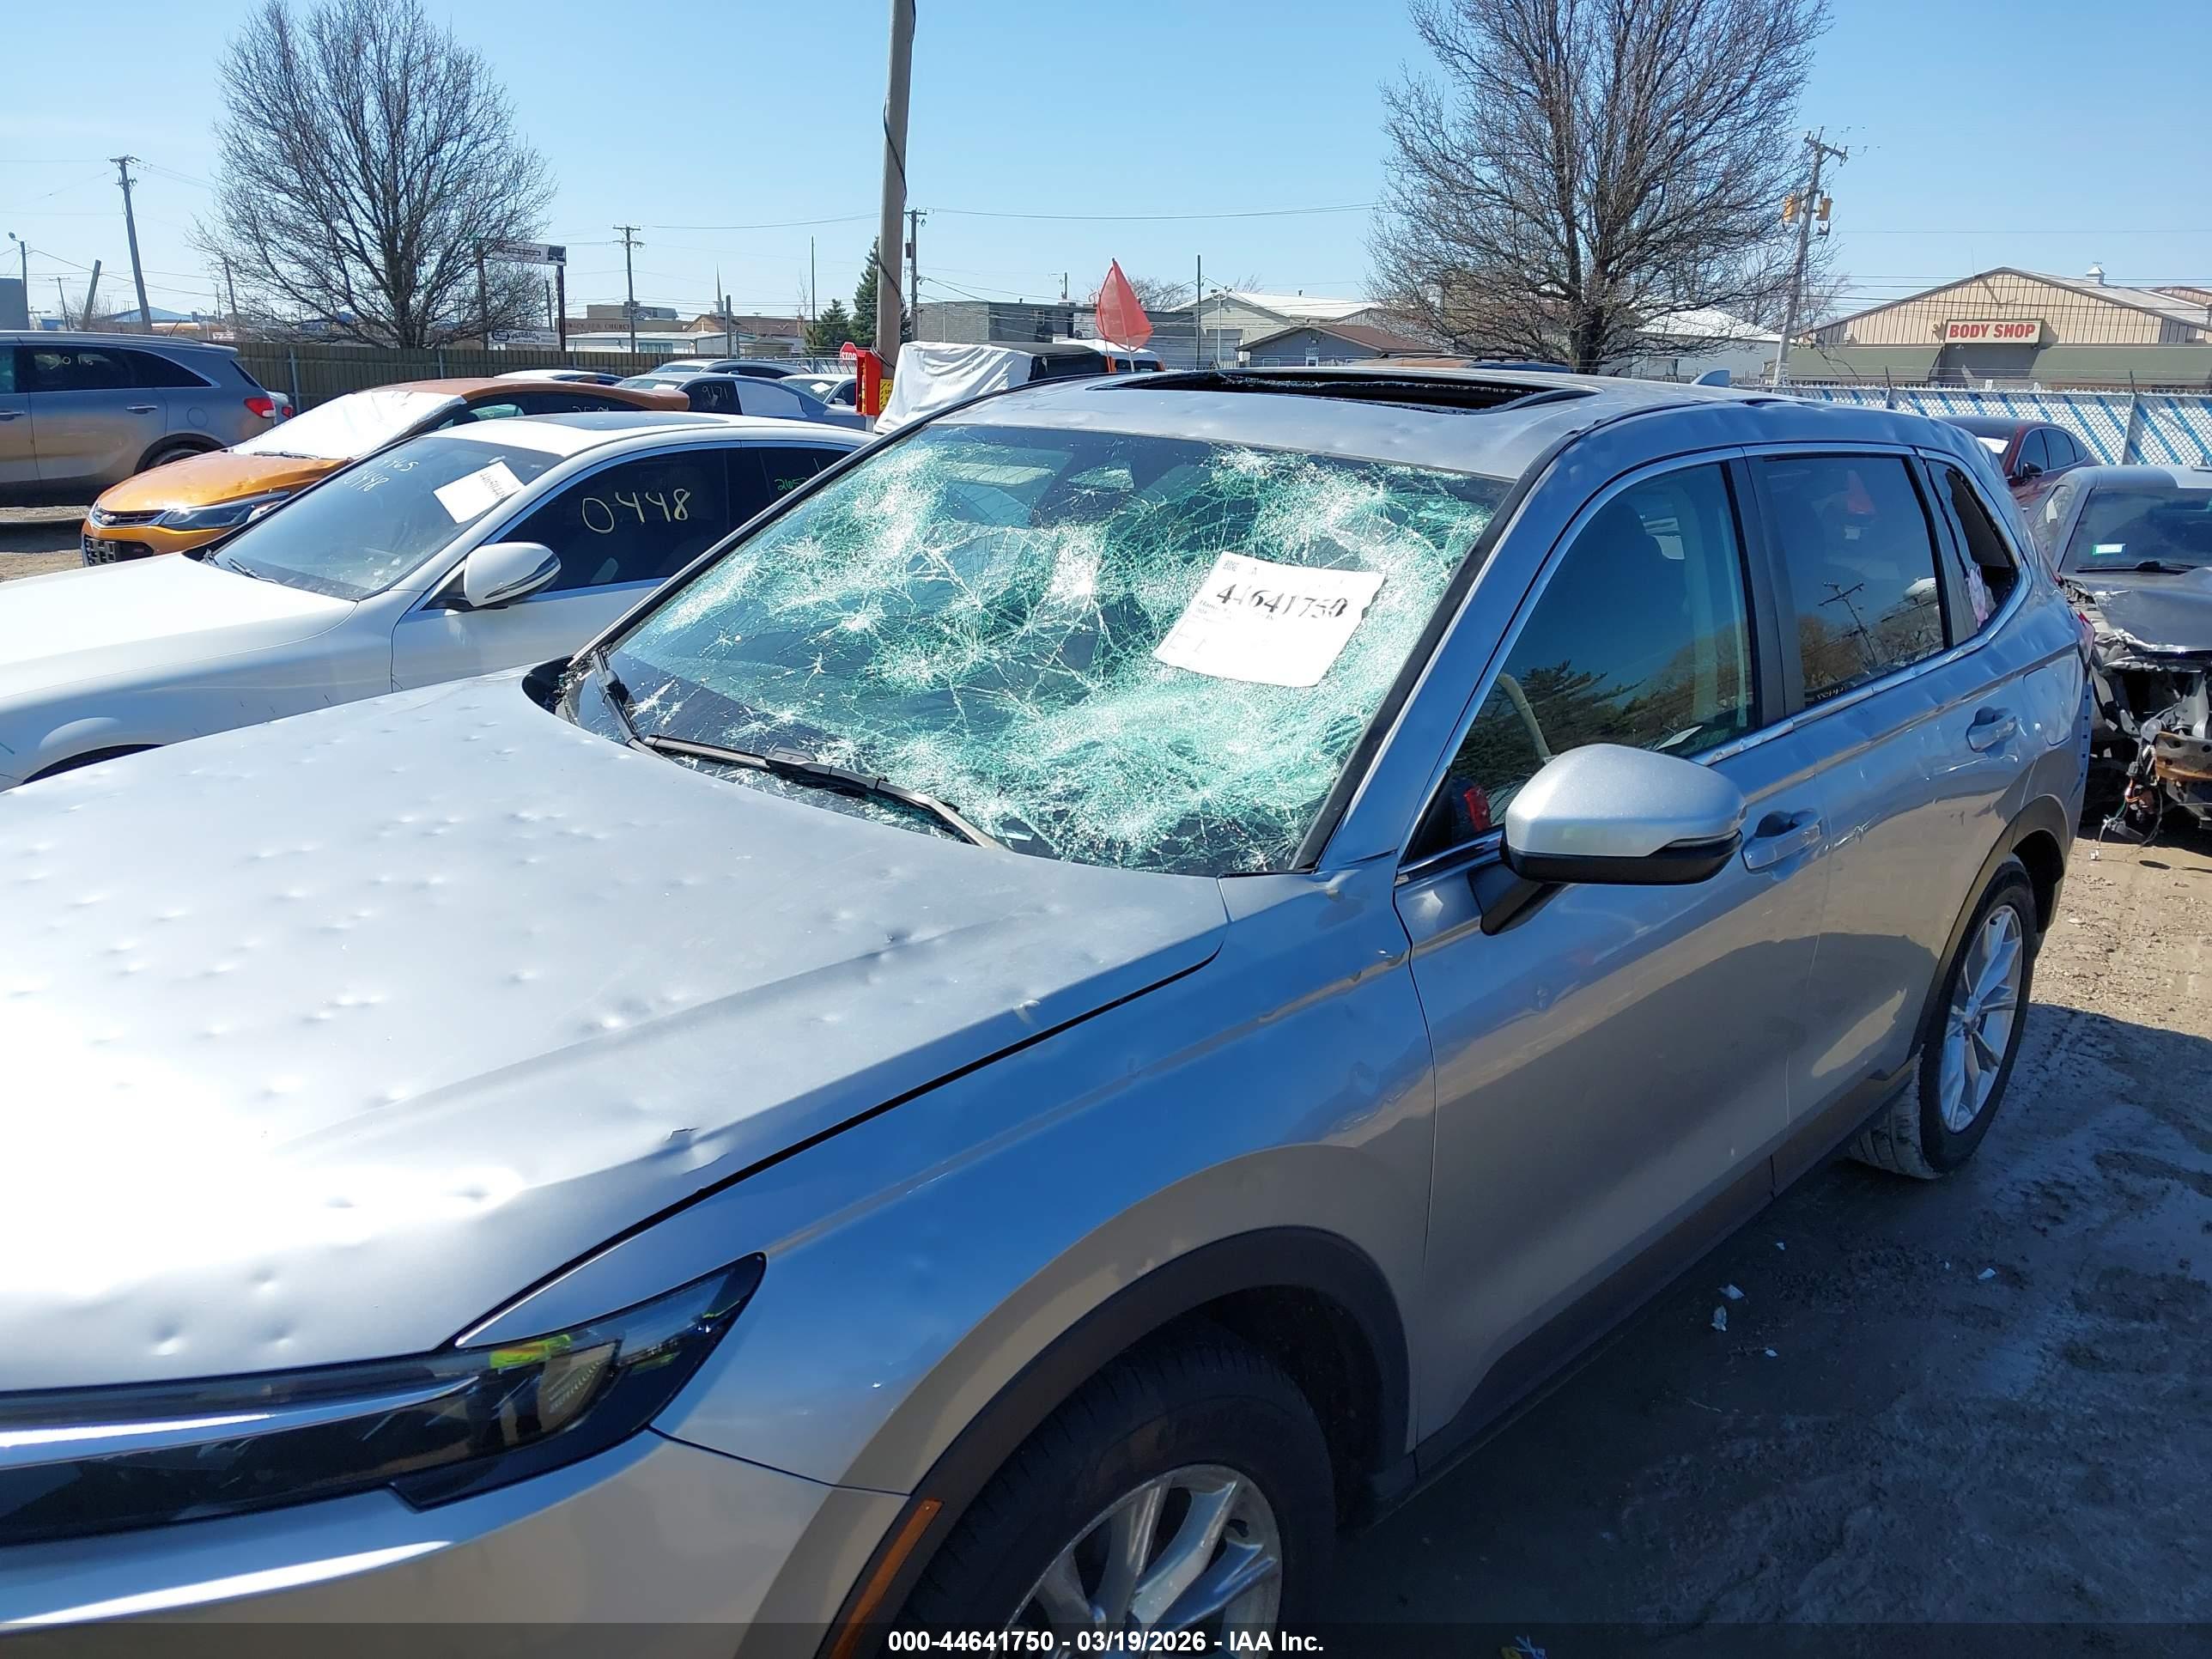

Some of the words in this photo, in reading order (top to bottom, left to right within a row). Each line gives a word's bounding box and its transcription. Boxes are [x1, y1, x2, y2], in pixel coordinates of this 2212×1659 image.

[1949, 324, 1990, 338] BODY
[1993, 324, 2035, 338] SHOP
[702, 385, 728, 400] 9171
[581, 488, 690, 534] 0448
